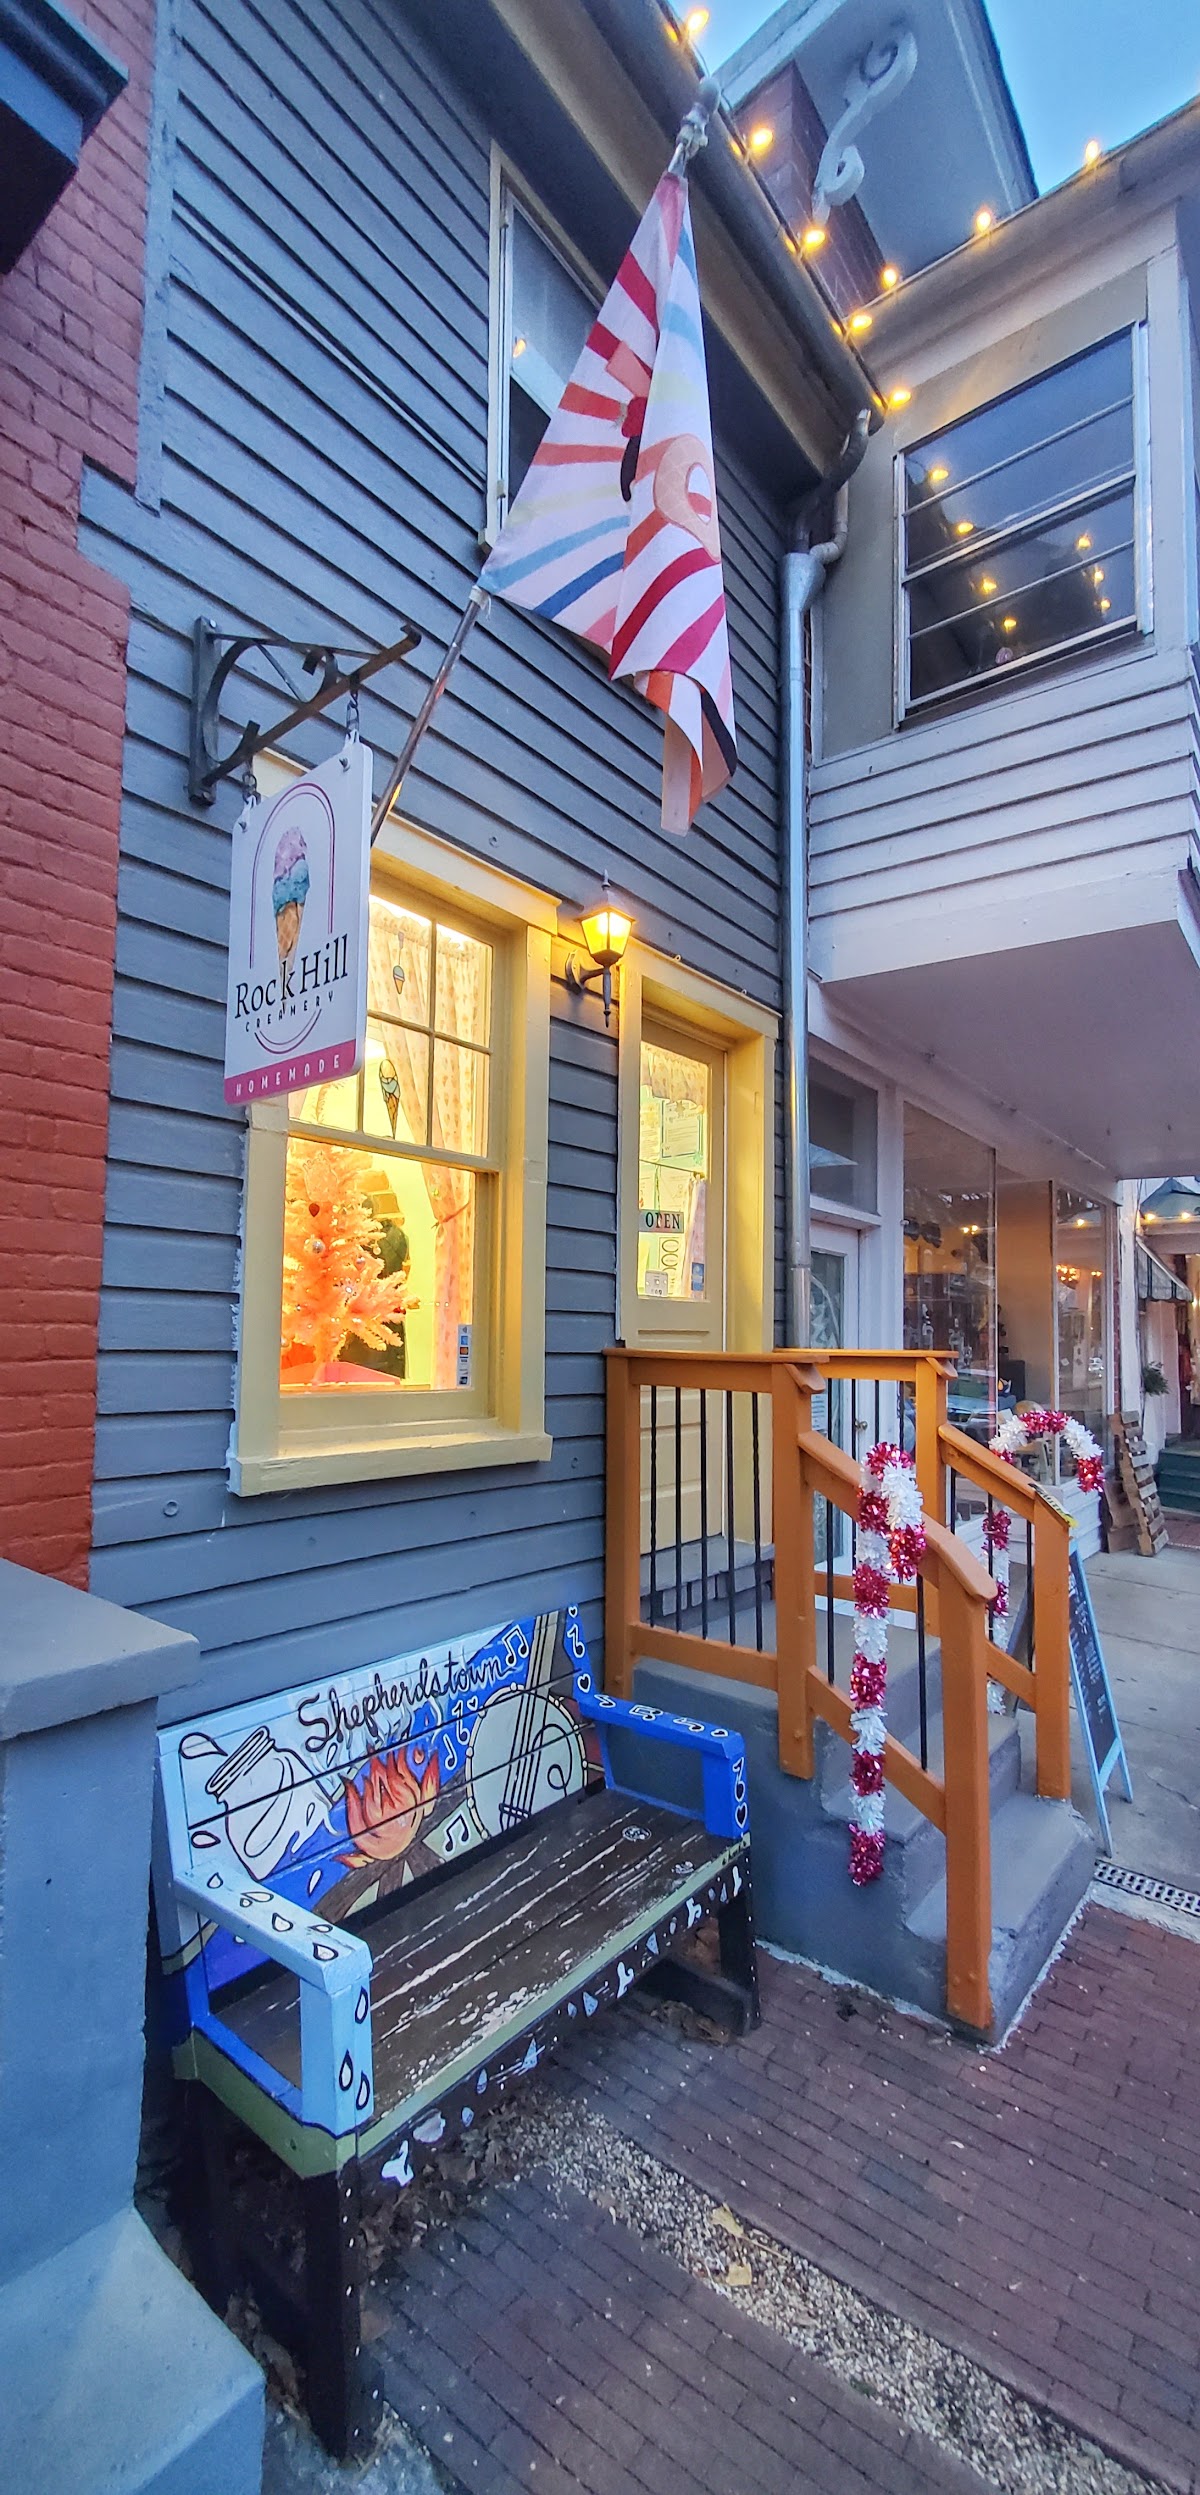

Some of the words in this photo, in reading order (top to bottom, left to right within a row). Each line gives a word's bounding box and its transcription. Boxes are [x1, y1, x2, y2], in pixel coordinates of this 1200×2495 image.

[234, 960, 295, 1018] Rock
[300, 933, 348, 994] Hill
[245, 990, 334, 1032] CREAMERY
[236, 1054, 340, 1096] HOMEMADE
[645, 1212, 680, 1229] OPEN
[297, 1650, 505, 1753] Shepherdstown
